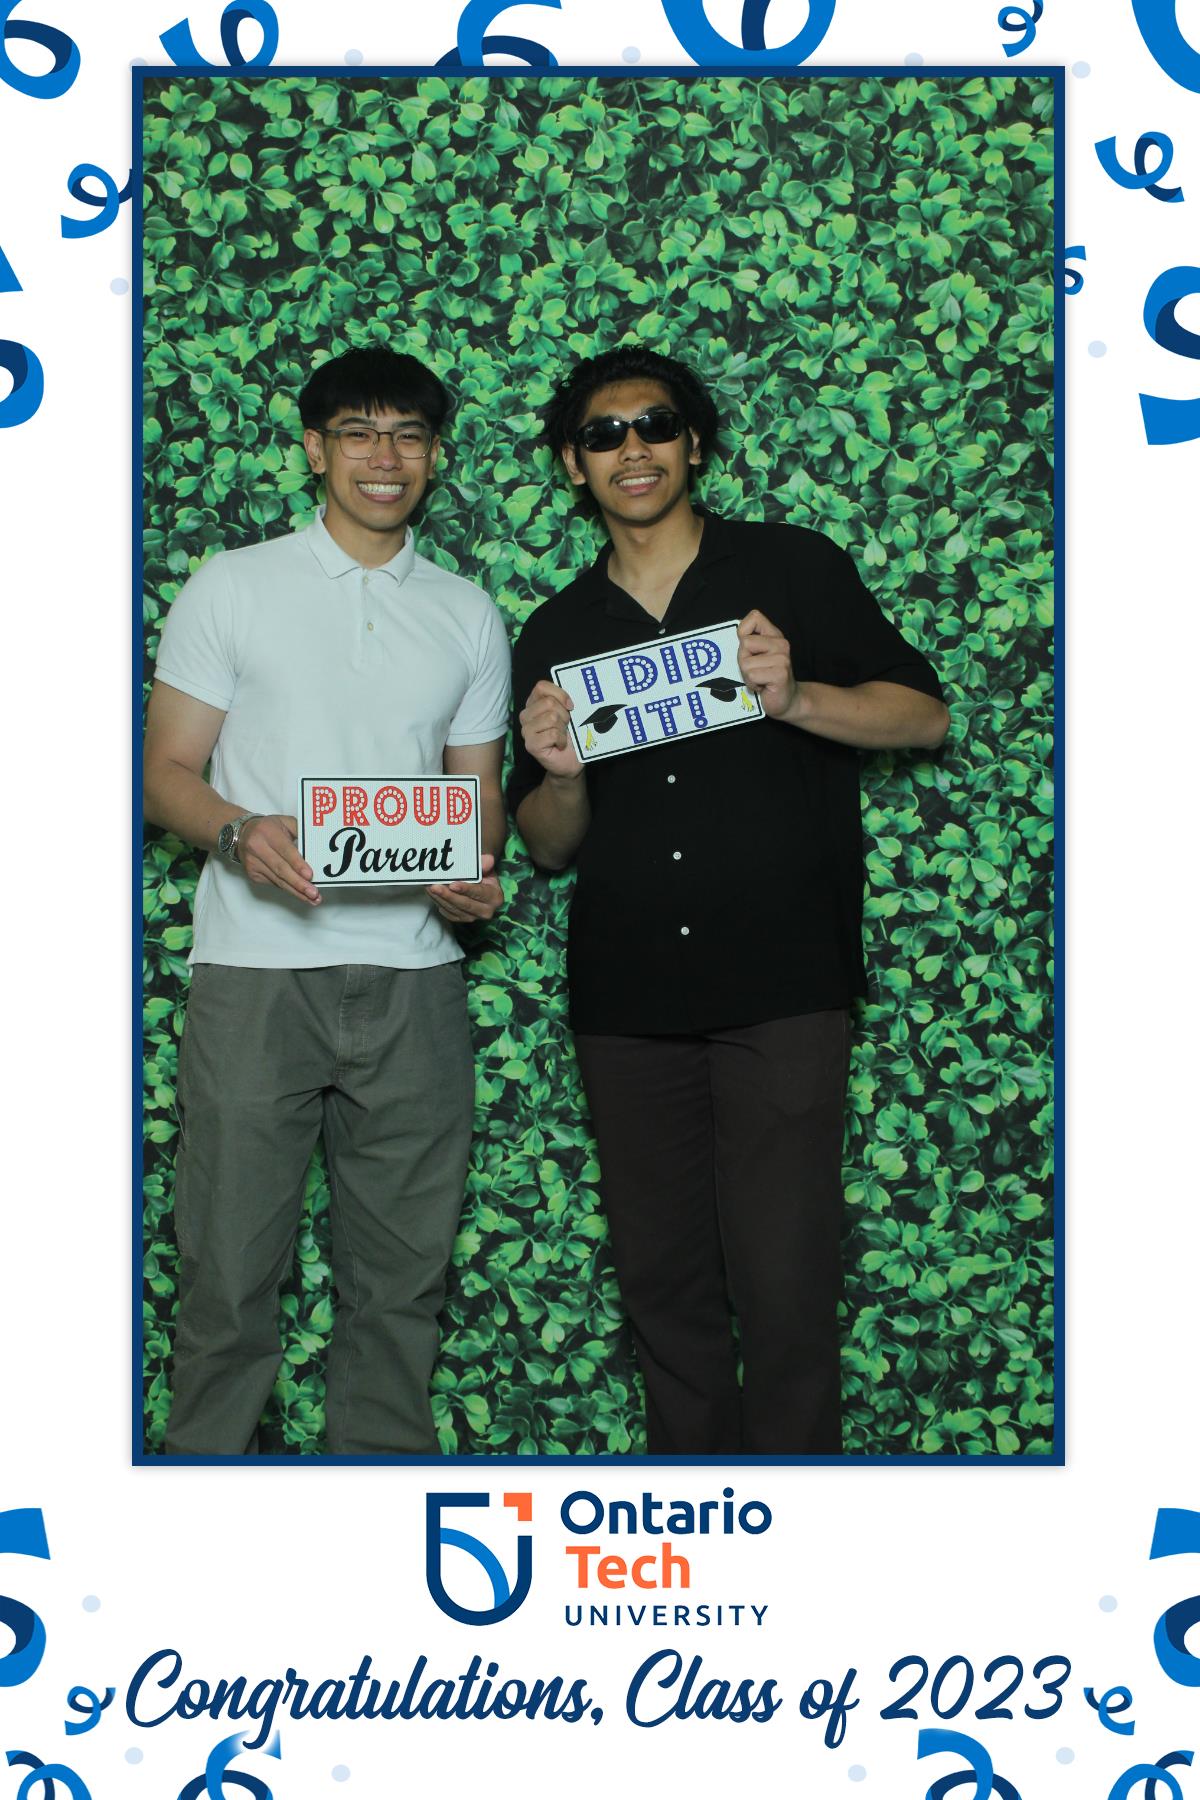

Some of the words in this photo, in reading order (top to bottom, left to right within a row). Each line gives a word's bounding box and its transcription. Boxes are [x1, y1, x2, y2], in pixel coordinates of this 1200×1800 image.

[580, 666, 605, 704] I
[617, 638, 722, 695] DID
[624, 691, 709, 744] IT!
[311, 785, 473, 827] PROUD
[322, 826, 455, 878] Parent
